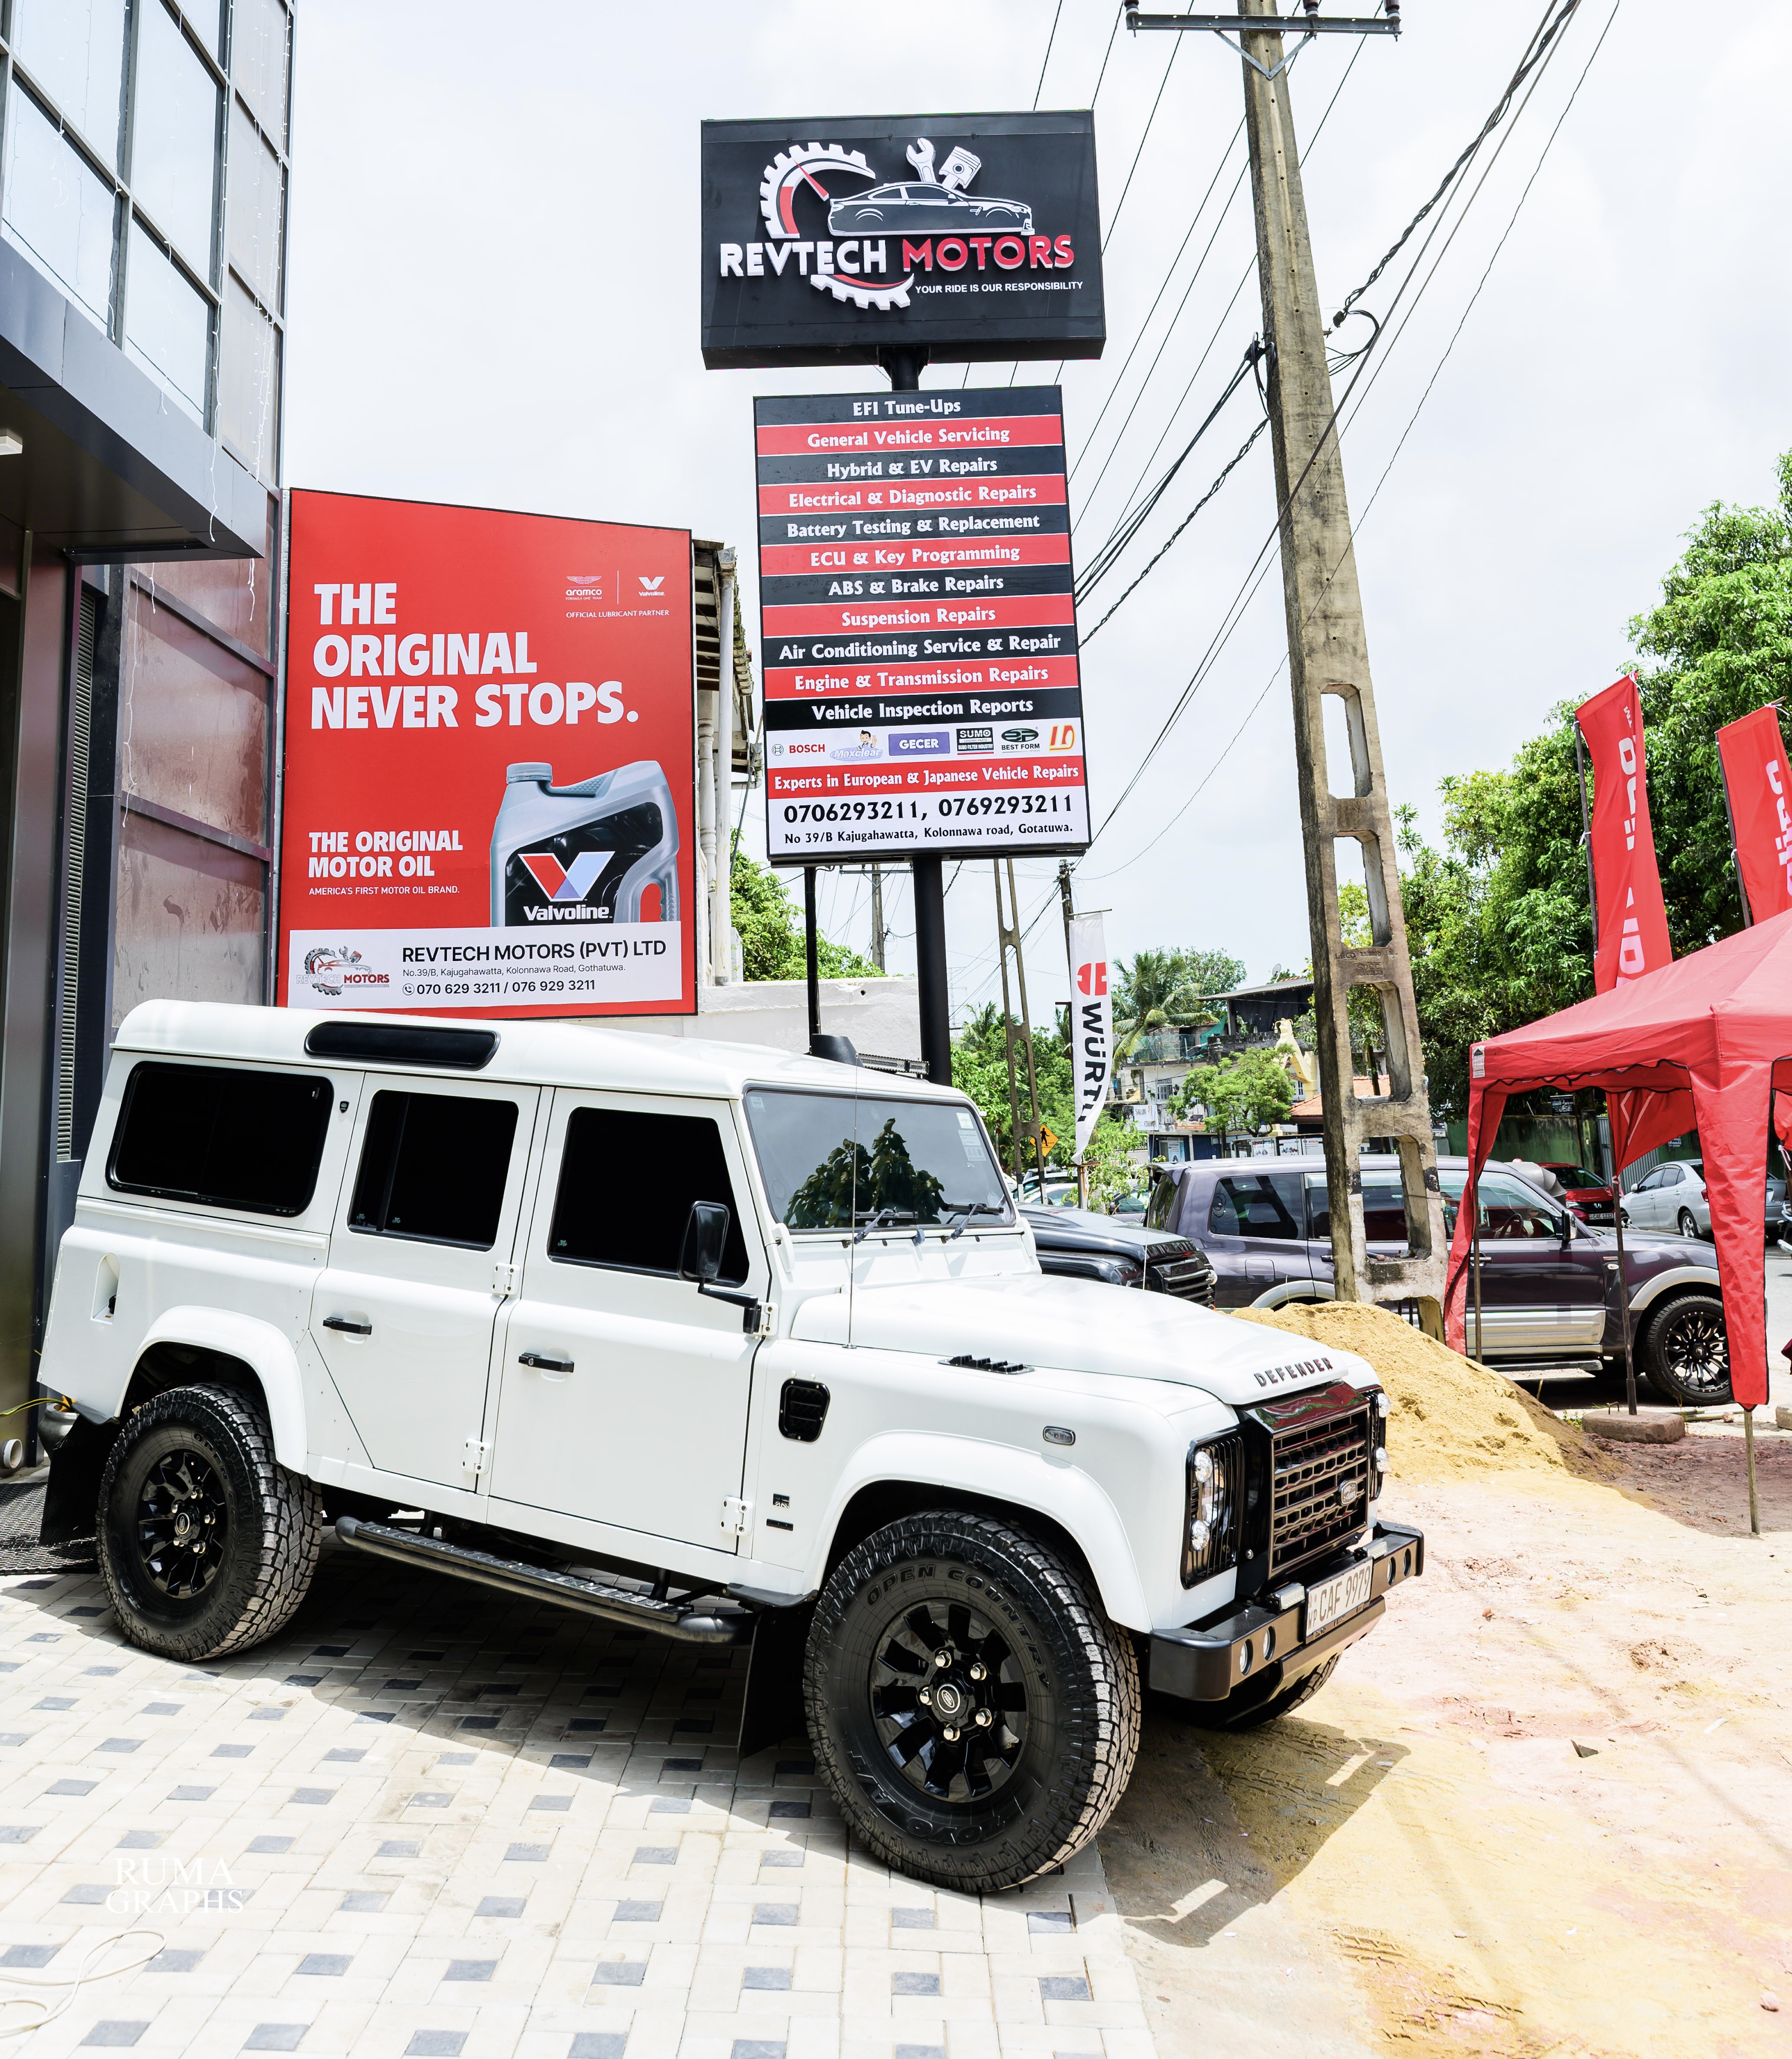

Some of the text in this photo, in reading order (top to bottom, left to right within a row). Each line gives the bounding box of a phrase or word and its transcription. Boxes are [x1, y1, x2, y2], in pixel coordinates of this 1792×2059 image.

[721, 234, 1074, 277] REVTECH MOTORS
[1005, 282, 1083, 291] RESPONSIBILITY
[853, 399, 961, 416] EFI Tune-Ups
[807, 427, 1010, 447] General Vehicle Servicing
[827, 457, 997, 479] Hybrid & EV Repairs
[789, 485, 1036, 507] Electrical & Diagnostic Repairs
[787, 516, 1040, 537] Battery Testing & Replacement
[811, 545, 1020, 566] ECU & Key Programming
[828, 575, 1003, 595] ABS & Brake Repairs
[314, 583, 396, 625] THE
[842, 606, 995, 628] Suspension Repairs
[313, 632, 537, 677] ORIGINAL
[779, 634, 1061, 659] Air Conditioning Service & Repair
[795, 665, 1048, 691] Engine & Transmission Repairs
[312, 681, 638, 729] NEVER STOPS.
[812, 700, 1033, 720] Vehicle Inspection Reports
[899, 738, 939, 750] GECER
[959, 729, 991, 738] SUMO
[789, 743, 825, 753] BOSCH
[834, 748, 880, 759] Maxclear
[775, 764, 1078, 791] Experts in European & Japanese Vehicle Repairs
[784, 795, 1071, 822] 0706293211, 0769293211
[309, 830, 463, 852] THE ORIGINAL
[785, 824, 1072, 843] No 39/B Kajugahawatta, Kolonnawa road, Gotatuwa.
[309, 856, 435, 877] MOTOR OIL
[524, 905, 609, 921] Valvoline
[403, 940, 665, 962] REVTECH MOTORS (PVT) LTD
[296, 974, 390, 984] REVTECH MOTORS
[441, 968, 503, 977] Kajugahawatta,
[417, 980, 594, 994] 070 629 3211 / 076 929 3211
[1147, 1241, 1196, 1256] LAND ROVER
[1254, 1357, 1334, 1387] DEFENDER
[1320, 1566, 1371, 1622] CAF 9979
[866, 1564, 1050, 1691] OPEN COUNTRY
